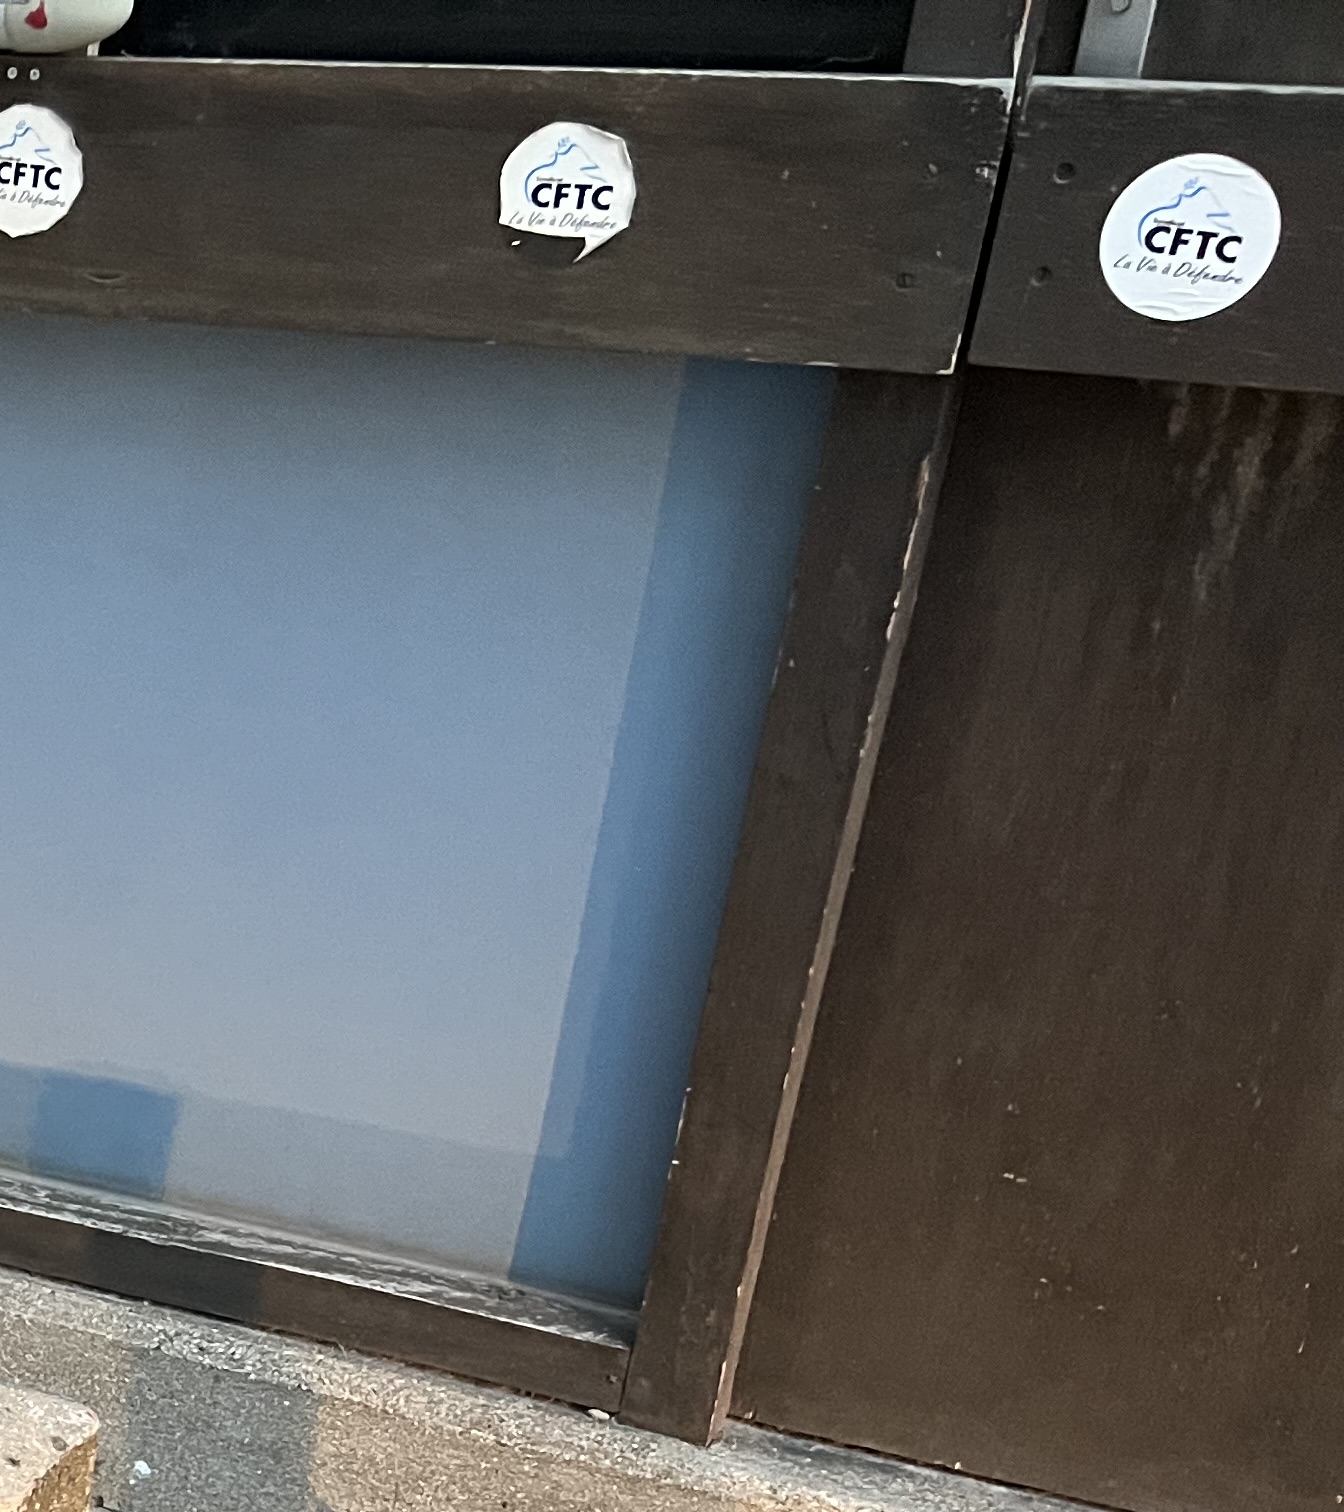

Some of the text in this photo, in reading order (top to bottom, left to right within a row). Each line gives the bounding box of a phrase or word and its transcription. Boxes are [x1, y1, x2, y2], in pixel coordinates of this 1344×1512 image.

[531, 183, 614, 210] CFTC
[508, 211, 524, 225] La
[1145, 225, 1243, 263] CFTC
[1113, 254, 1132, 269] La
[1136, 256, 1158, 272] Vie
